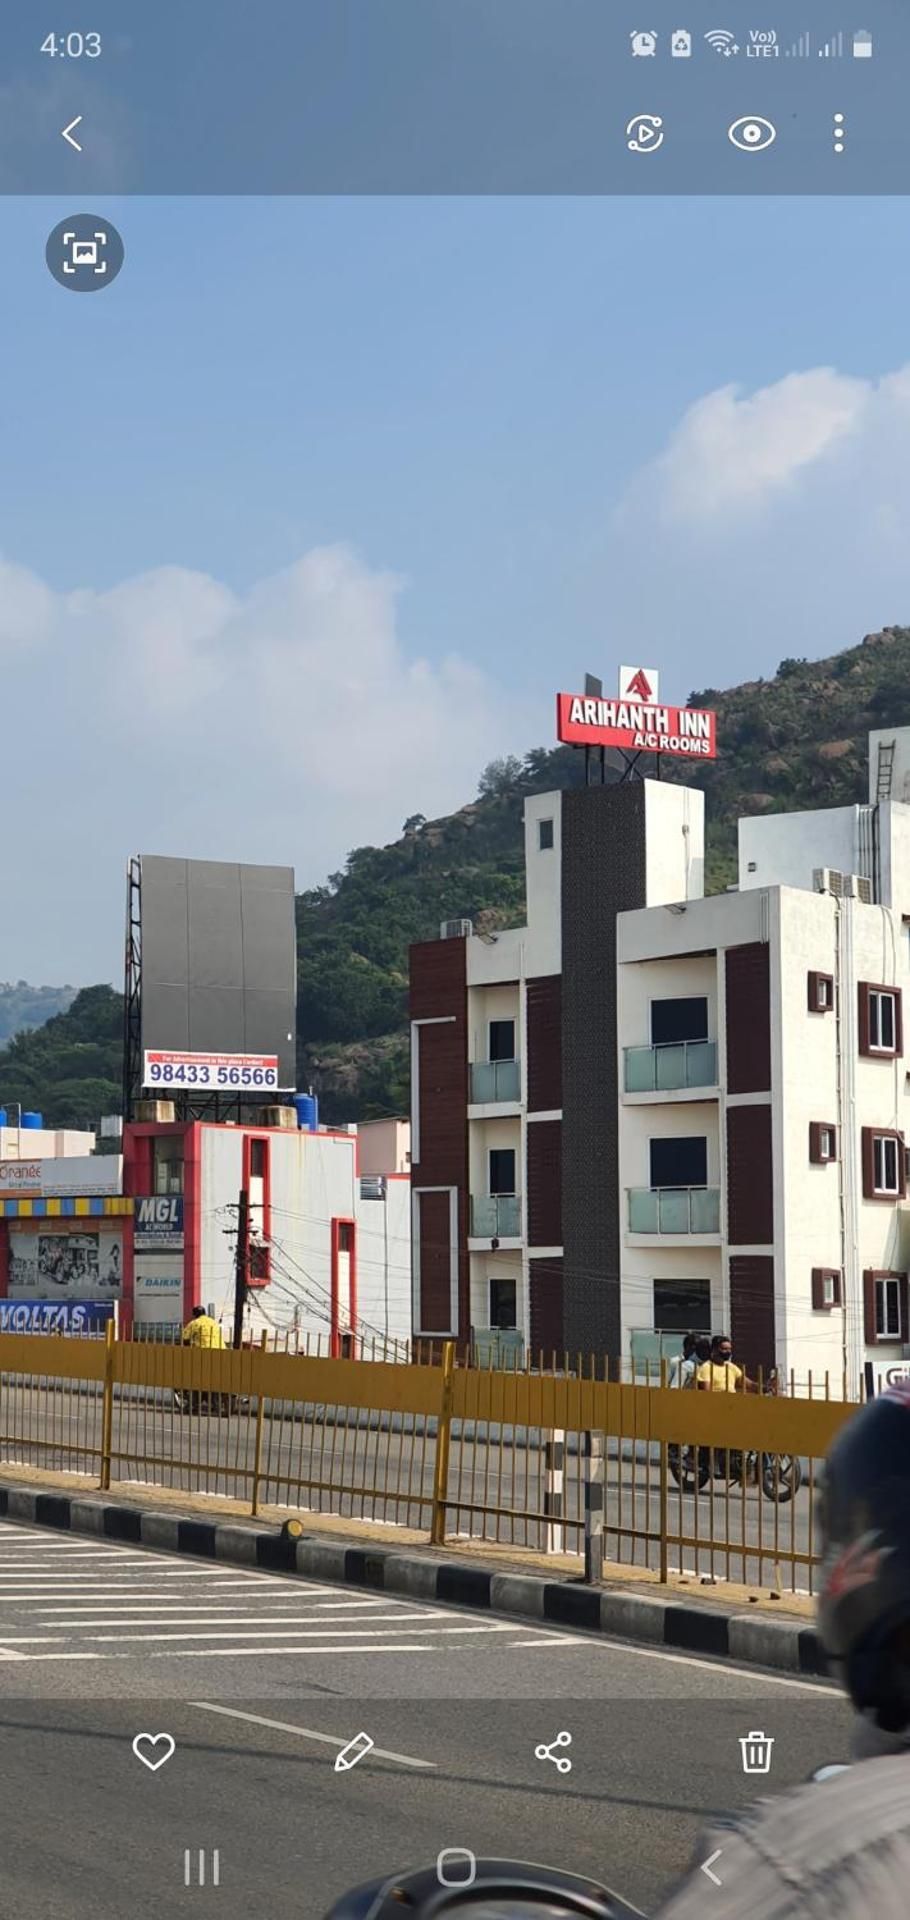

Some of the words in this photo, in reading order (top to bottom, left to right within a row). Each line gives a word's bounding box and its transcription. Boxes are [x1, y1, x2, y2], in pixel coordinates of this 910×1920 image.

[569, 697, 669, 733] ARIHANTH
[679, 711, 711, 738] INN
[634, 732, 657, 747] A/C
[659, 734, 711, 754] ROOMS
[150, 1063, 210, 1083] 98433
[217, 1066, 276, 1085] 56566
[138, 1198, 179, 1222] MGL
[144, 1278, 182, 1288] DAIKIN
[0, 1305, 86, 1329] VOLTAS
